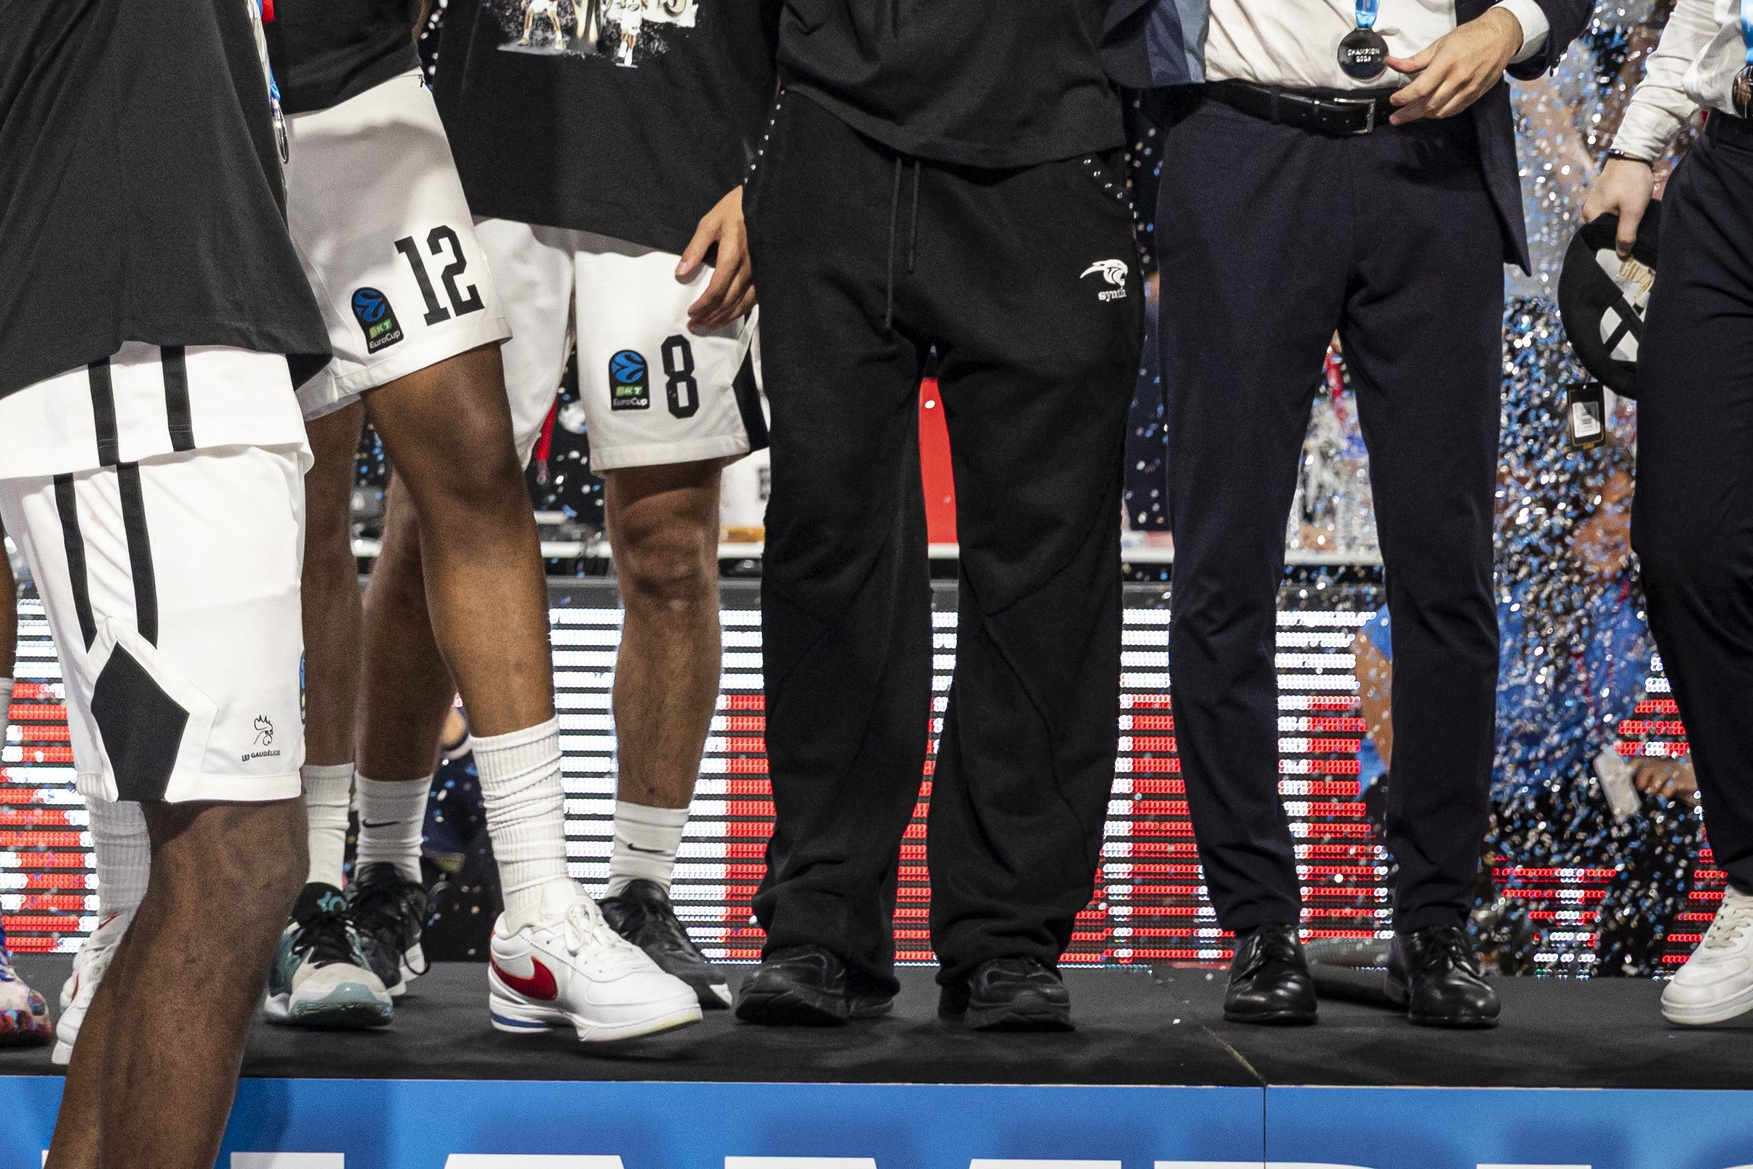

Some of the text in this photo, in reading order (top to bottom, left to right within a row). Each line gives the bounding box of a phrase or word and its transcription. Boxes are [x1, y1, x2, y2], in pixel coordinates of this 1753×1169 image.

[394, 225, 485, 327] 12
[369, 330, 401, 349] EuroCup
[613, 397, 648, 407] EuroCup
[661, 334, 700, 419] 8
